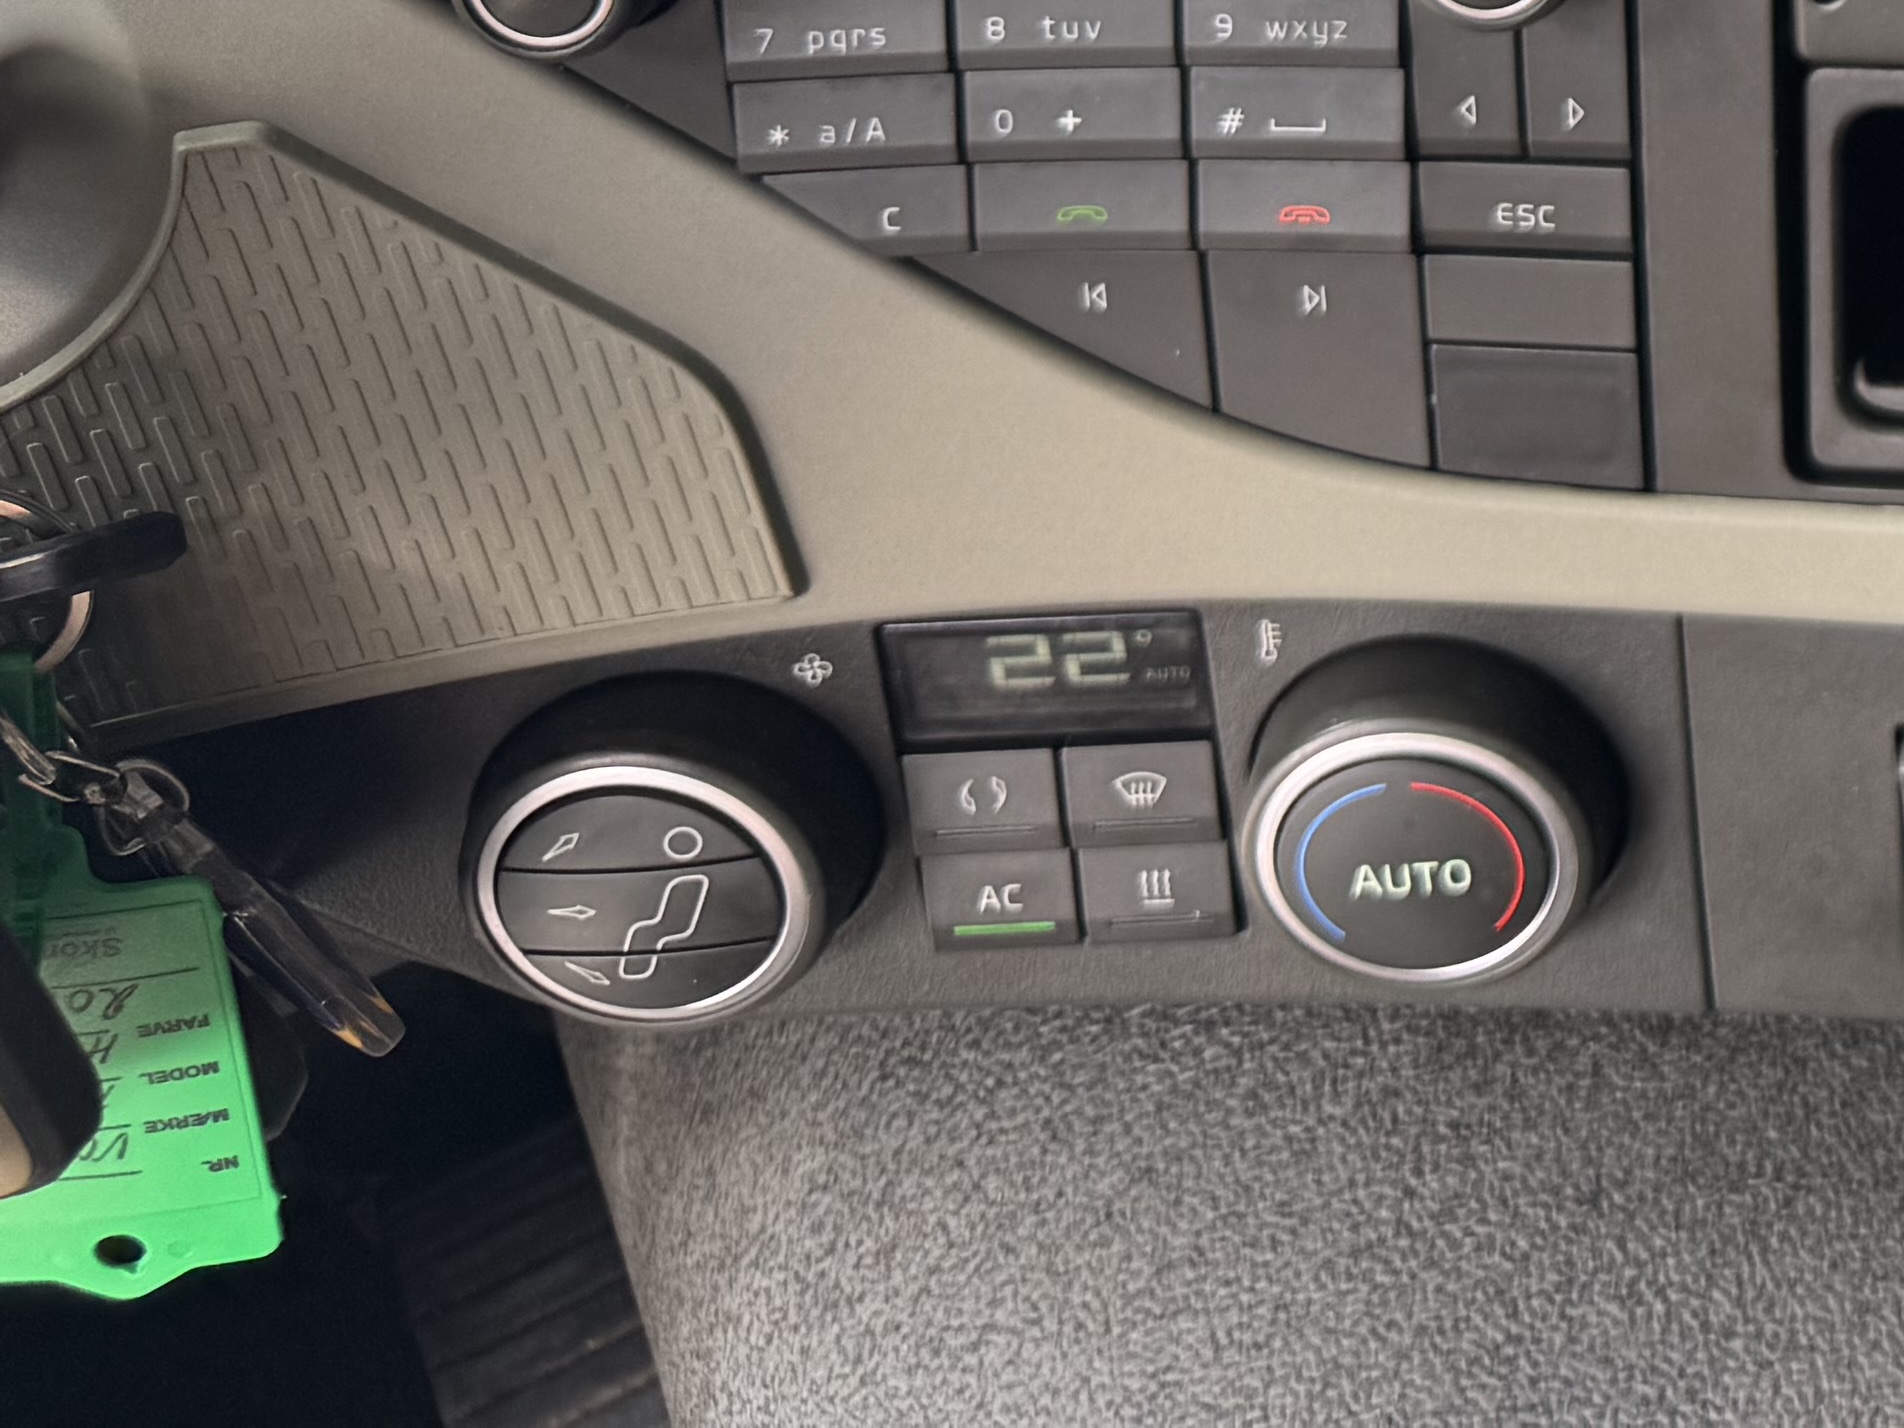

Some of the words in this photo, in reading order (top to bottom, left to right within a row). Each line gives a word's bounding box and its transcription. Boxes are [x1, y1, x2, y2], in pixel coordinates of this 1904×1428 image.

[755, 28, 774, 55] 7
[807, 27, 886, 56] pqrs
[986, 16, 1005, 42] 8
[1042, 16, 1100, 42] tuv
[1214, 13, 1233, 39] 9
[1266, 19, 1348, 46] wxyz
[995, 109, 1014, 135] 0
[881, 208, 901, 233] C
[1496, 203, 1556, 230] ESC
[1145, 666, 1191, 681] AUTO
[1350, 859, 1472, 899] AUTO
[977, 884, 1023, 912] AC
[137, 1013, 211, 1038] FARVE
[138, 1060, 220, 1085] MODEL
[143, 1108, 230, 1134] MÆRKE
